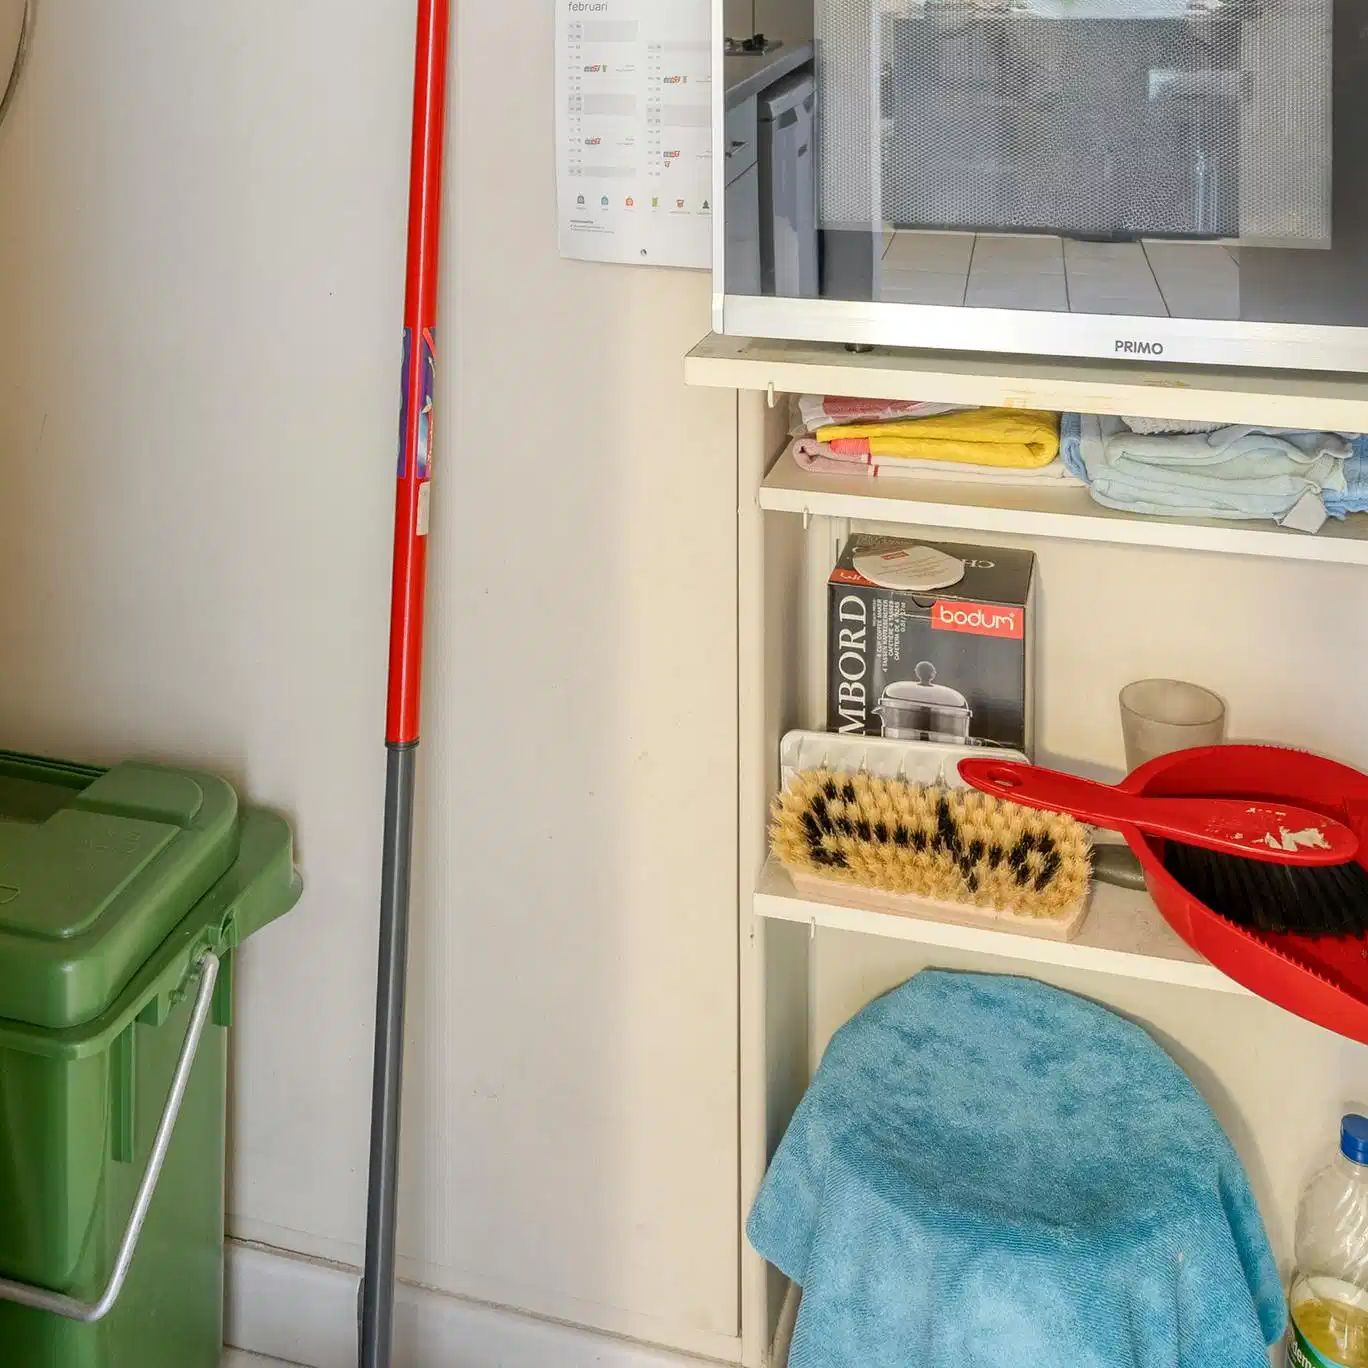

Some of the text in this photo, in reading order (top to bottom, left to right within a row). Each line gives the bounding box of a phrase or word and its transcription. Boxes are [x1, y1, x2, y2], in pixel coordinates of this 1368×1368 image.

[568, 0, 608, 13] februari
[1114, 339, 1164, 355] PRIMO
[939, 605, 1015, 631] bodum
[838, 595, 867, 736] MBORD
